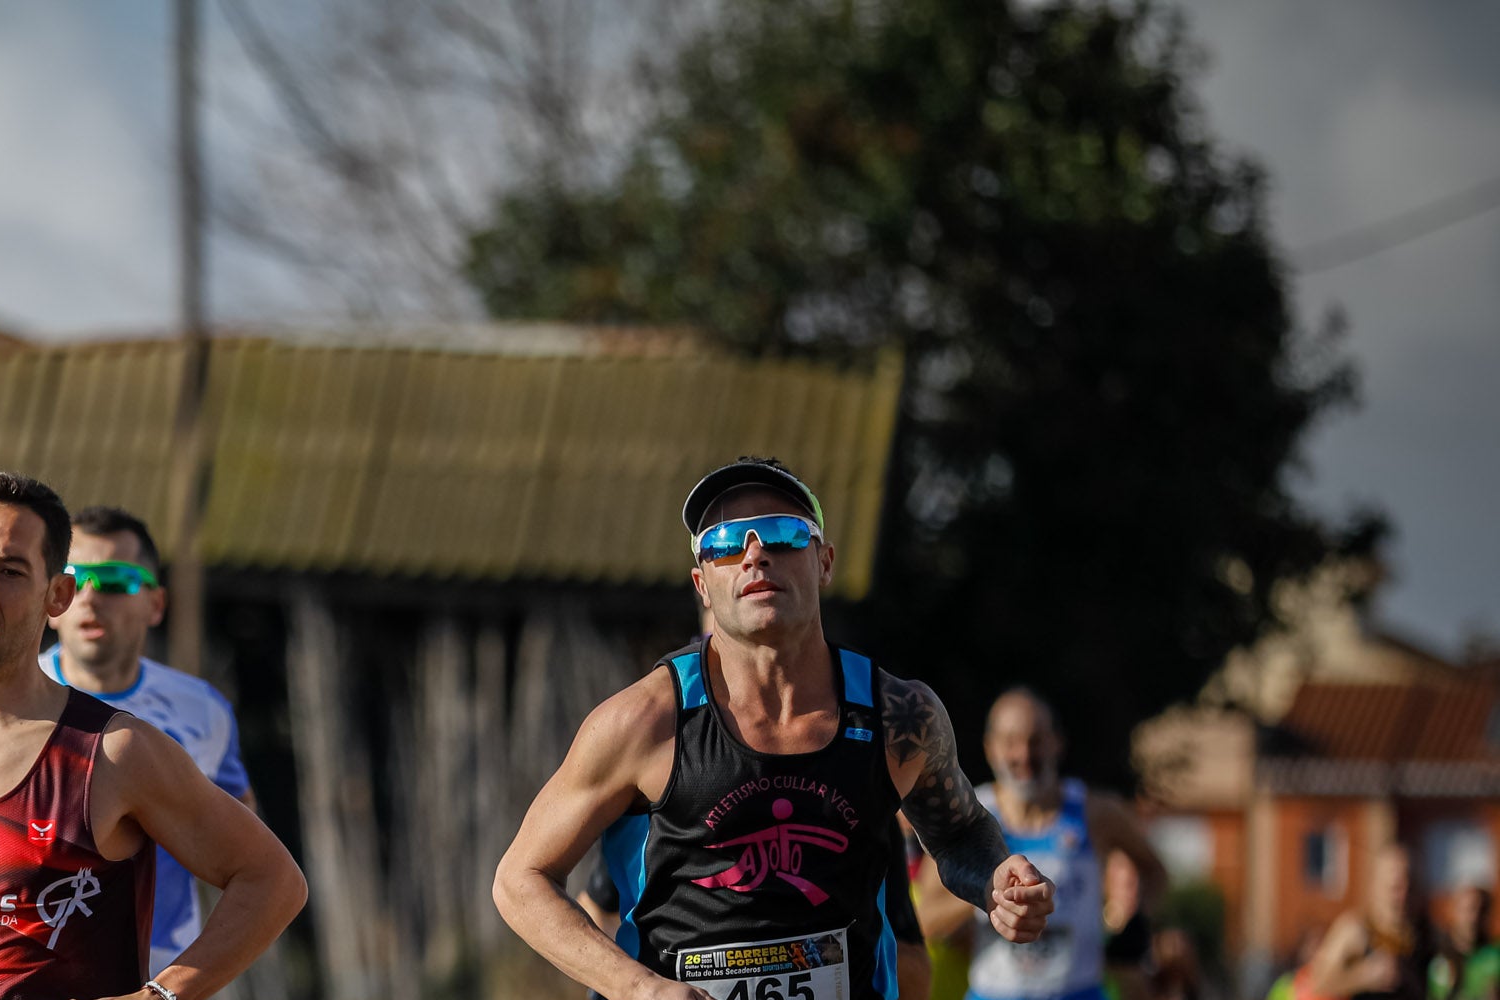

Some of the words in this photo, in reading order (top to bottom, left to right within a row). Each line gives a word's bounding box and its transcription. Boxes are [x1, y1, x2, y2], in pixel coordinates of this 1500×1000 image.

[704, 777, 770, 831] ATLETISMO
[774, 776, 828, 799] CULLAR
[830, 788, 861, 831] VEGA
[685, 954, 701, 964] 26
[713, 951, 727, 968] VII
[726, 946, 787, 959] CARRERA
[727, 955, 788, 967] POPULAR
[702, 969, 712, 977] de
[713, 968, 724, 976] los
[725, 967, 761, 976] Secaderos
